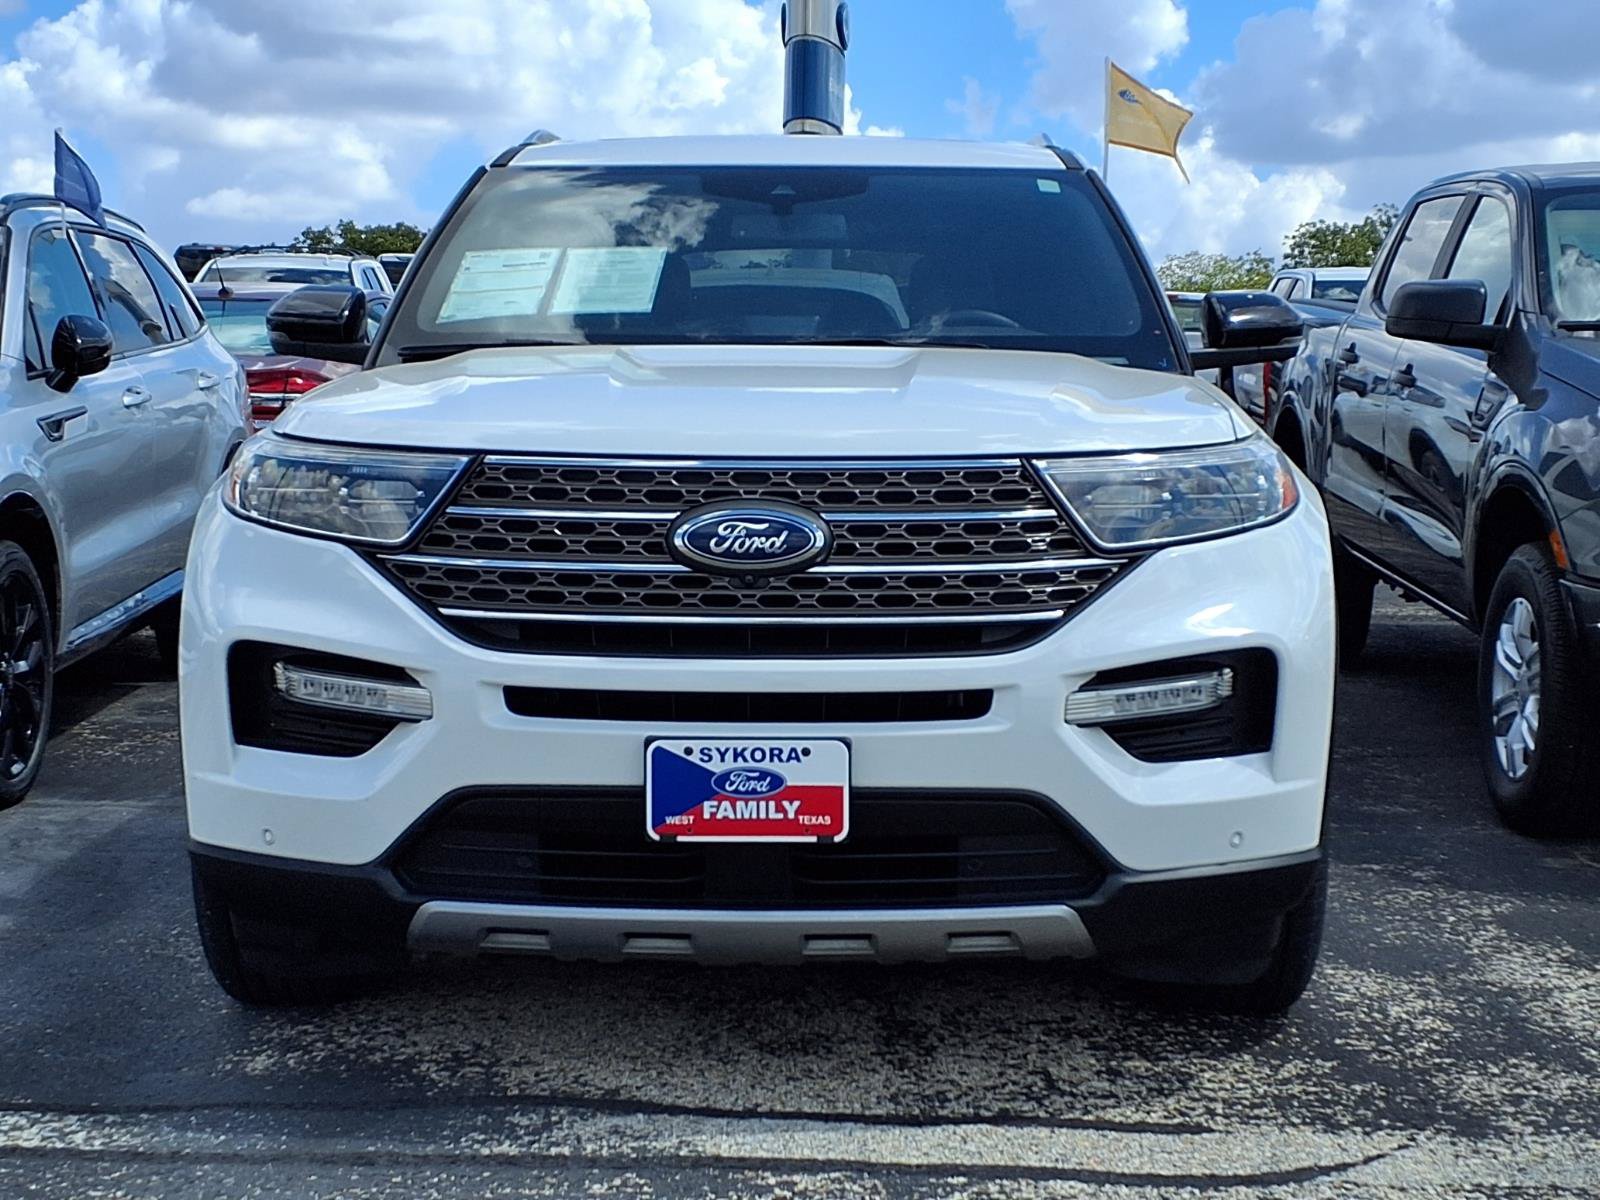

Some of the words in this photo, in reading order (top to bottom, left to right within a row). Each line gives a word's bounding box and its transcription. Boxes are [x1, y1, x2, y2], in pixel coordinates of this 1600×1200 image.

[709, 521, 789, 553] Ford
[699, 747, 801, 763] SYKORA
[725, 771, 770, 792] Ford
[703, 800, 801, 819] FAMILY
[665, 816, 694, 825] WEST
[799, 816, 831, 825] TEXAS
